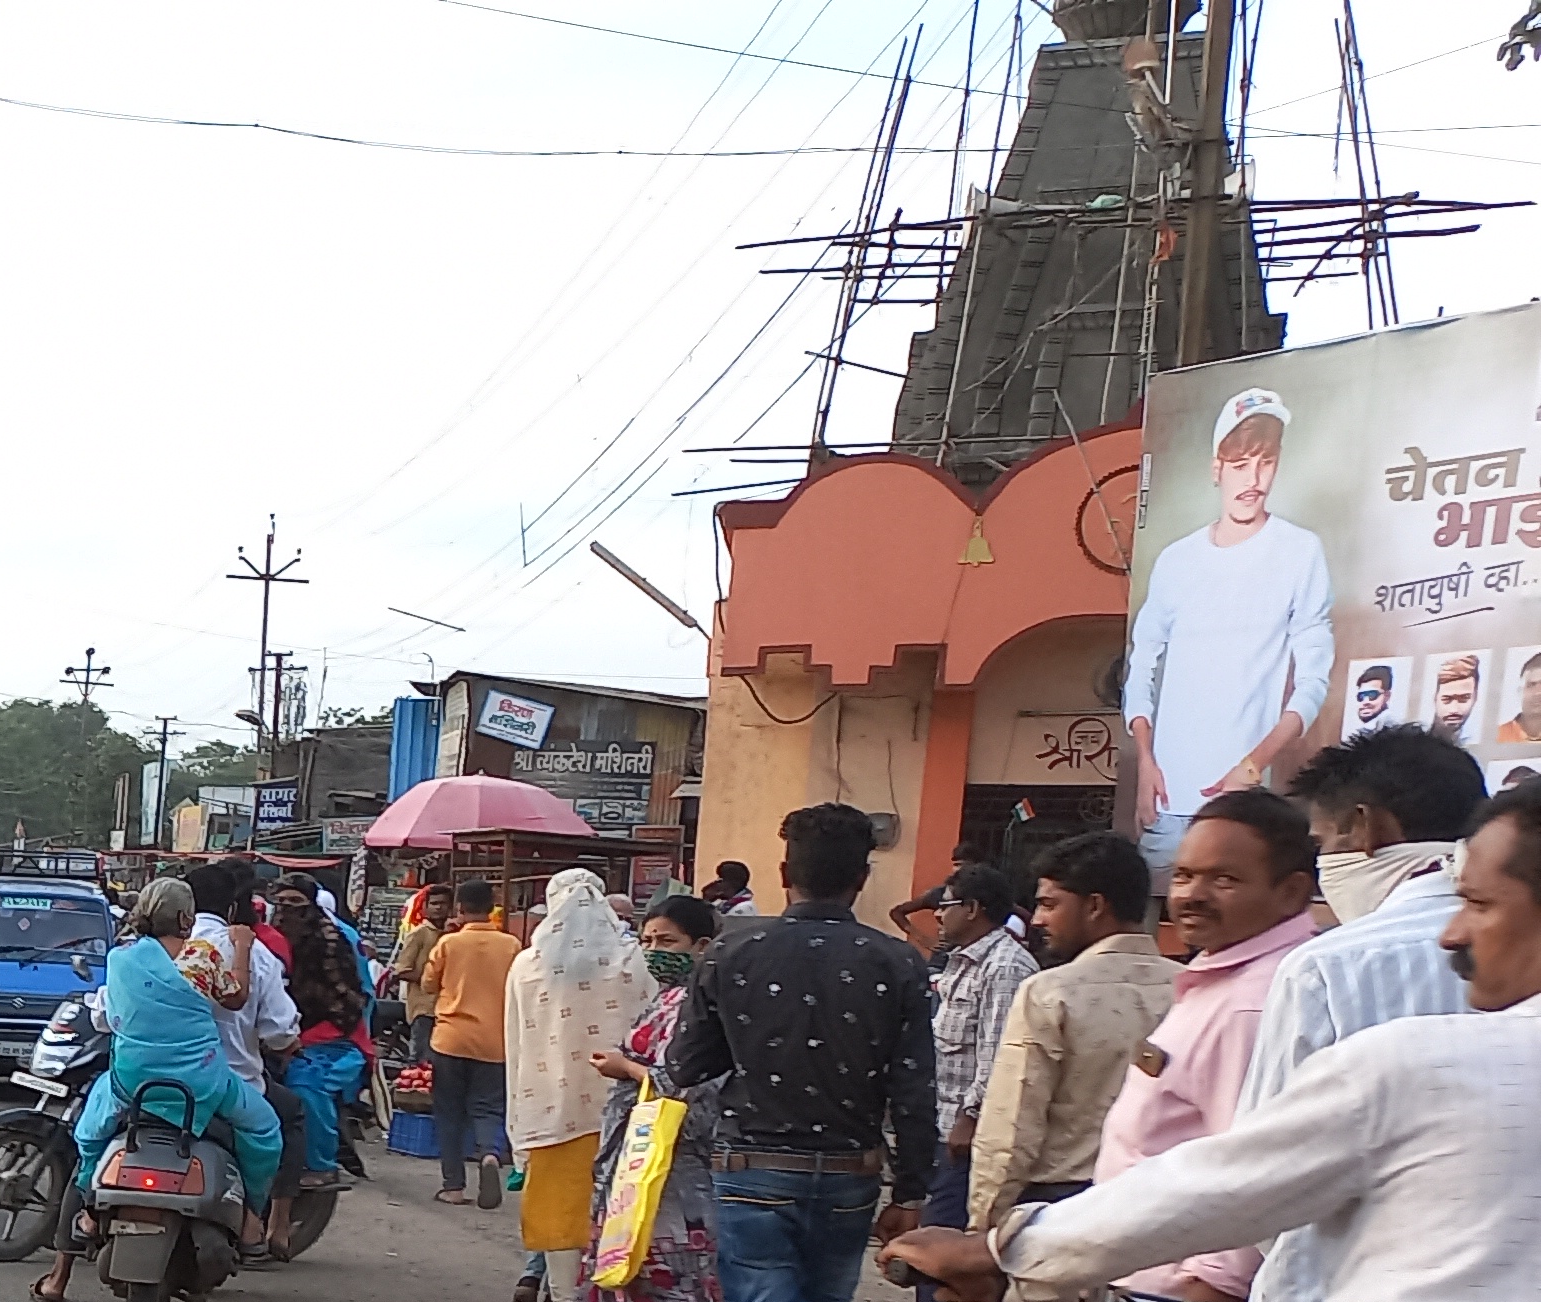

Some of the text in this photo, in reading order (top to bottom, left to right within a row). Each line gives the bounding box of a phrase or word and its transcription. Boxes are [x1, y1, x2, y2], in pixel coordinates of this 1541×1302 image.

[1385, 446, 1526, 501] चेतन
[1374, 562, 1474, 614] शतायुषी
[594, 743, 653, 775] मशिनरी
